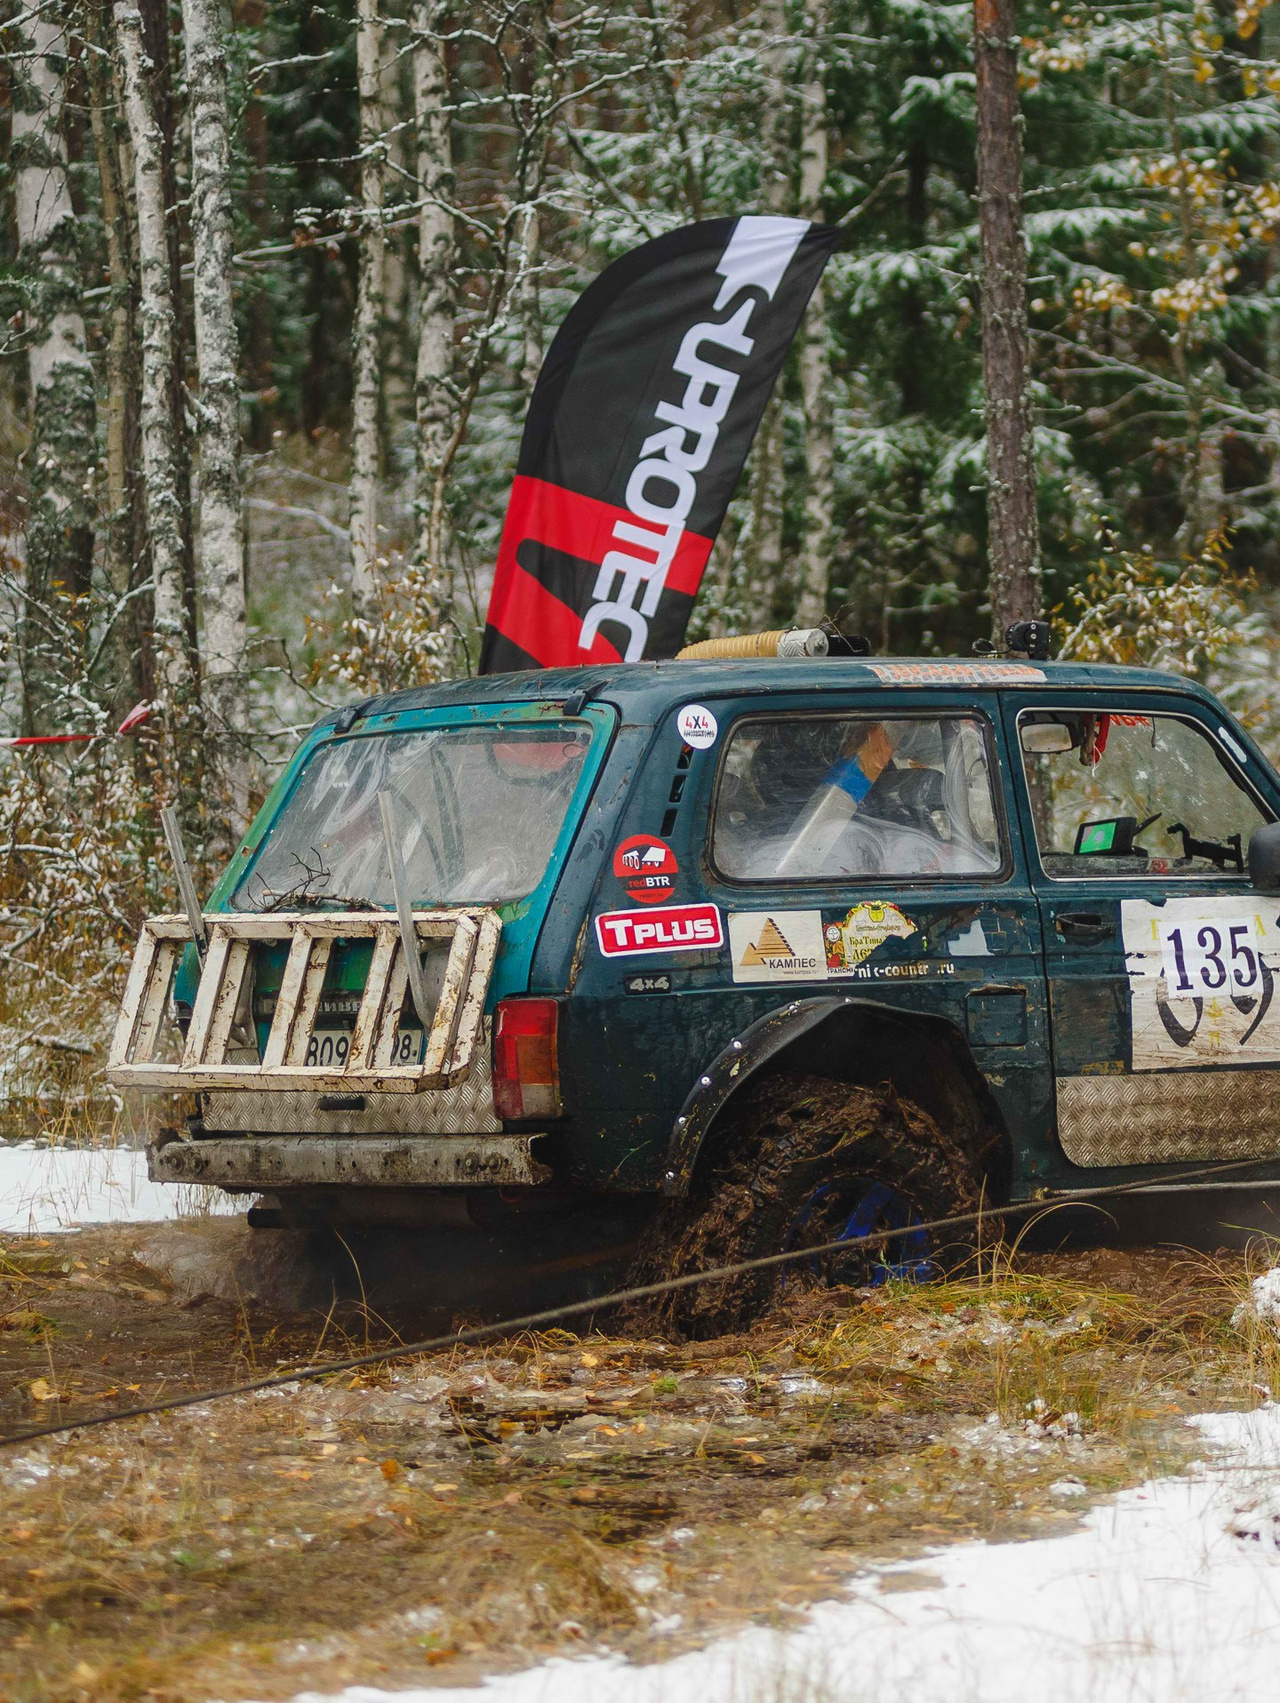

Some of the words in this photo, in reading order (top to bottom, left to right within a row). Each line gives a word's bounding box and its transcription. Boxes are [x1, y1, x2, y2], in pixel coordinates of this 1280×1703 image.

[578, 216, 811, 663] SUPROTEC
[628, 876, 670, 888] redBTR
[604, 918, 716, 946] TPLUS
[769, 958, 817, 969] КАМПЕС
[1166, 925, 1258, 991] 135
